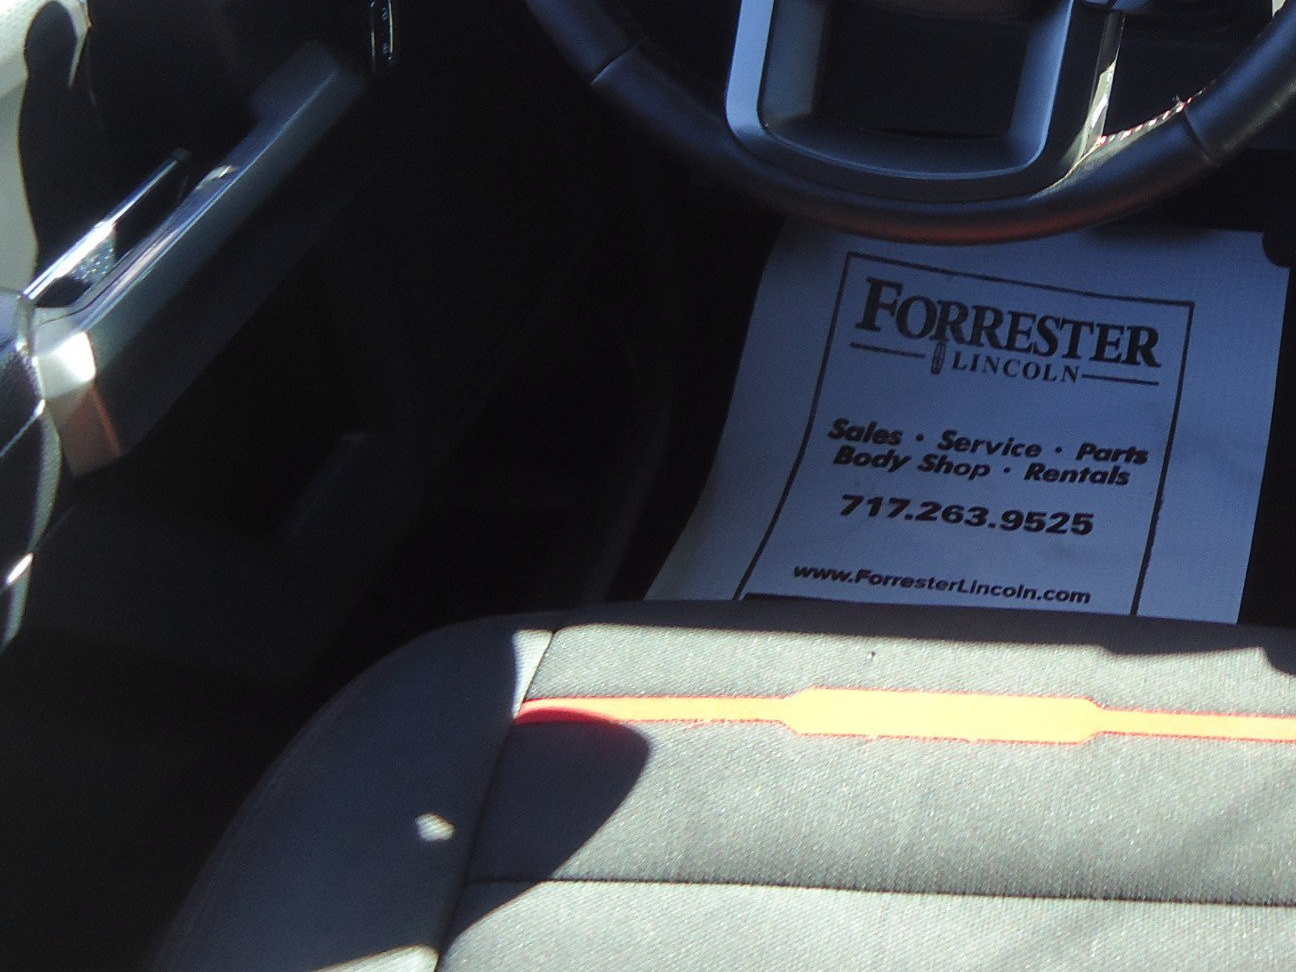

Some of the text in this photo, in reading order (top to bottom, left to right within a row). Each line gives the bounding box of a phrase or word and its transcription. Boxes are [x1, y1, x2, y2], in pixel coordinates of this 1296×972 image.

[855, 277, 1162, 369] FORRESTER
[951, 350, 1080, 384] LINCOLN
[827, 417, 1149, 465] Sales Service Parts
[832, 444, 1131, 487] Body Shop Rentals
[839, 493, 1095, 536] 717.263.9525
[793, 564, 1092, 605] www.ForresterLincoln.com
